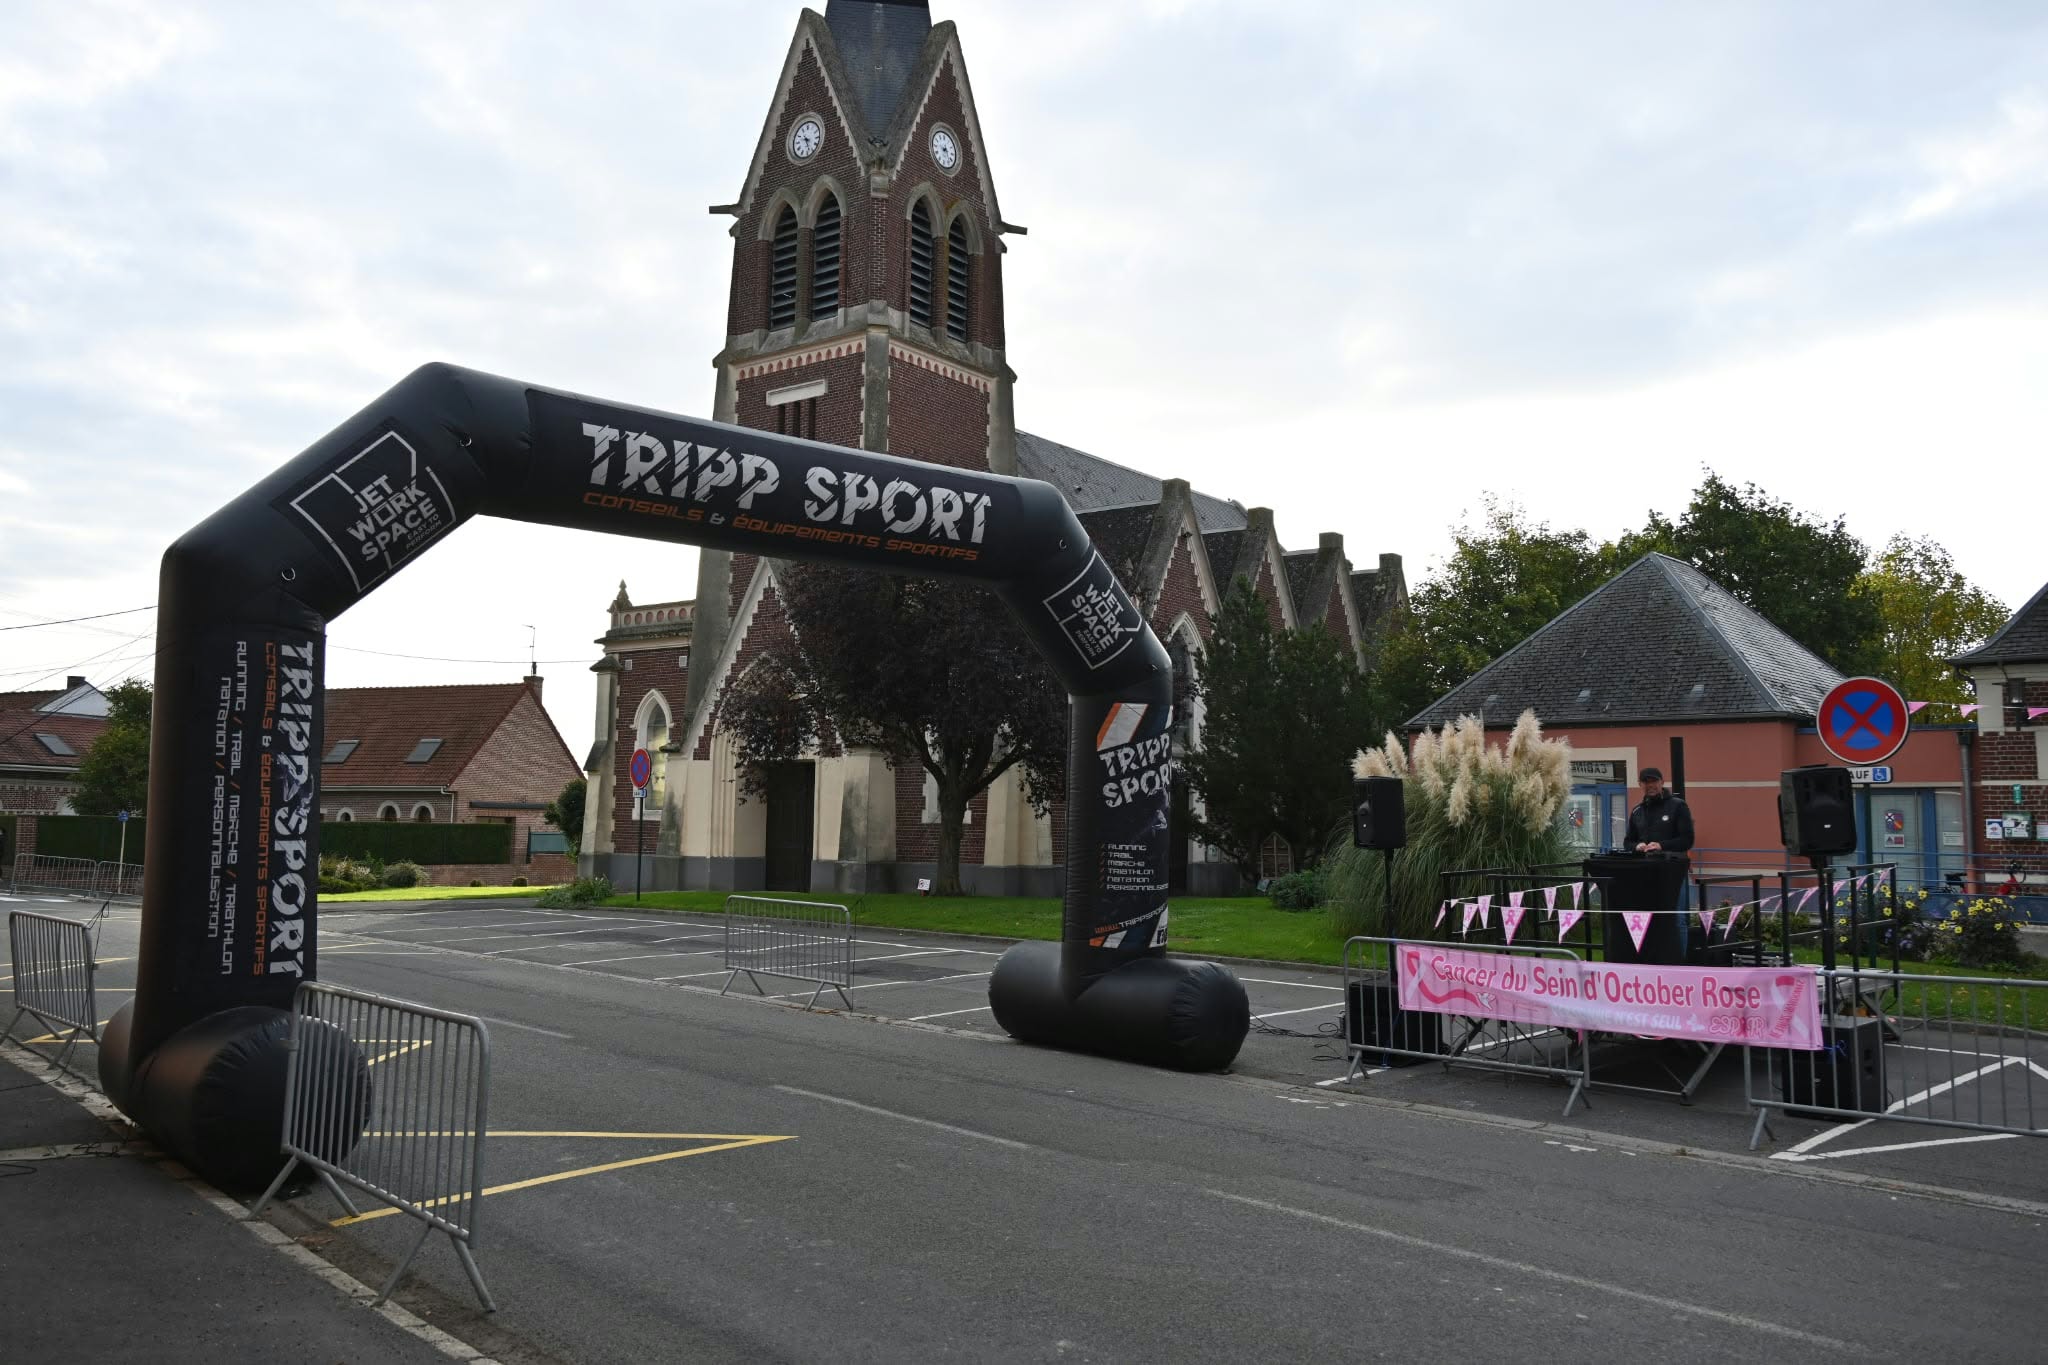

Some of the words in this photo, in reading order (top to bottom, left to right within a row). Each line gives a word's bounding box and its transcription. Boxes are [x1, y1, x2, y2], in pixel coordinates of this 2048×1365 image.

[354, 474, 388, 513] JET
[582, 422, 780, 510] TRIPP
[804, 466, 992, 544] SPORT
[347, 480, 426, 541] WORK
[362, 497, 436, 560] SPACE
[407, 522, 427, 540] EASY
[428, 514, 439, 525] TO
[709, 512, 726, 525] &
[885, 539, 979, 561] SPORTIFS
[1072, 594, 1114, 649] SPACE
[1085, 583, 1124, 640] WORK
[1102, 589, 1124, 615] JET
[277, 641, 314, 786] TRIPP
[262, 735, 272, 748] &
[1099, 732, 1170, 777] TRIPP
[1850, 770, 1870, 780] AUF
[270, 806, 309, 978] SPORT
[254, 886, 268, 976] SPORTIFS
[1431, 955, 1497, 988] Cancer
[1501, 963, 1527, 992] du
[1533, 966, 1578, 999] Sein
[1702, 976, 1761, 1009] Rose
